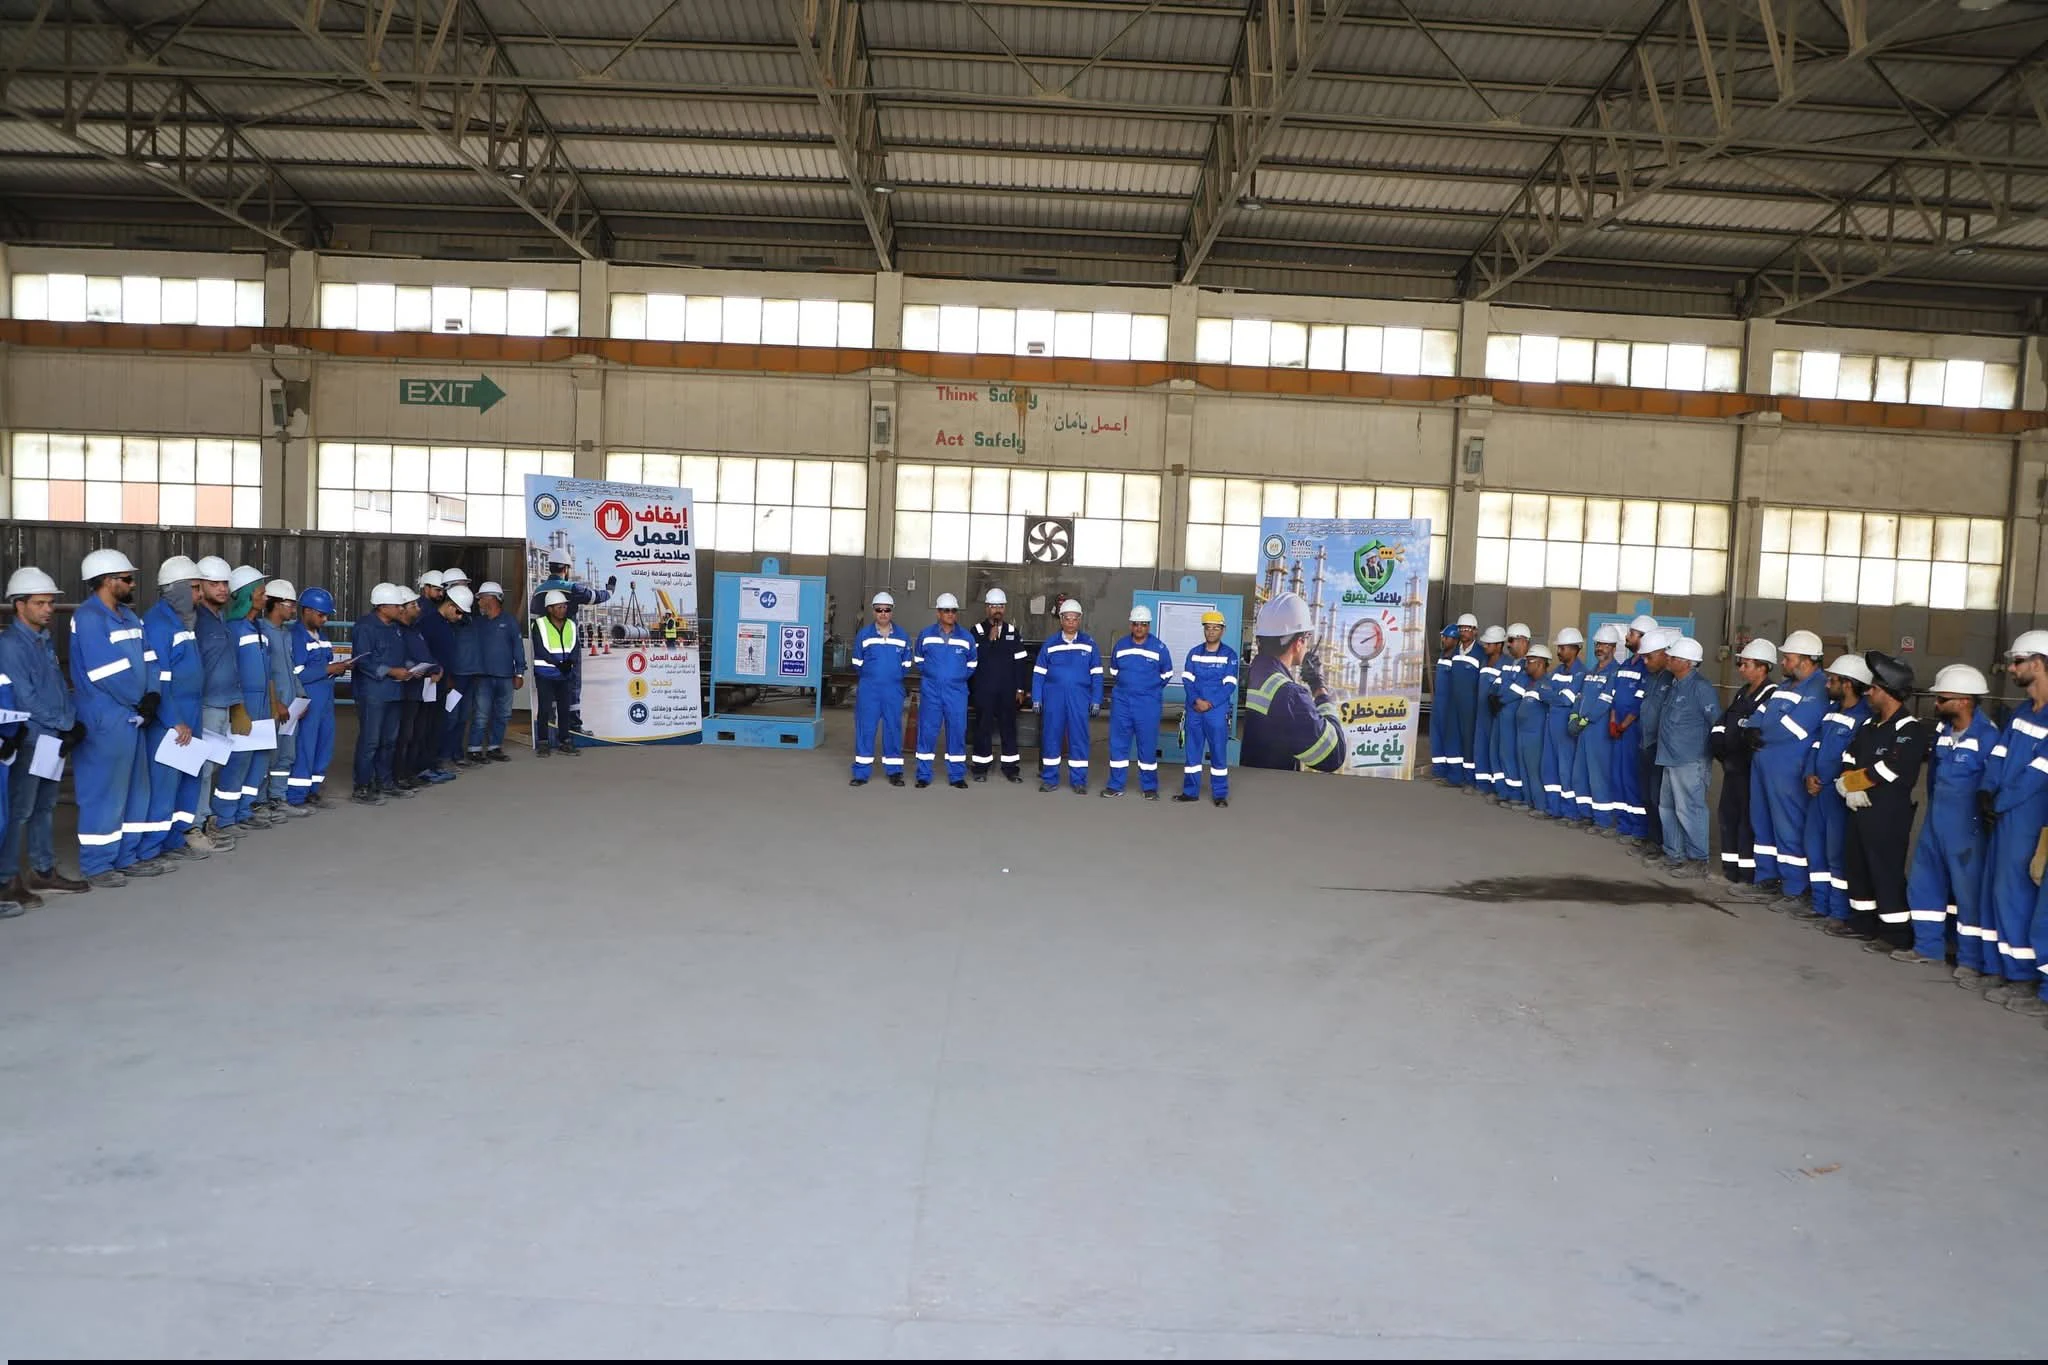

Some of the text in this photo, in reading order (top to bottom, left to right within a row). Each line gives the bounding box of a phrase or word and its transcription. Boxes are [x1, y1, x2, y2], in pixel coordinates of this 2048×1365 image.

[407, 382, 474, 403] EXIT
[935, 386, 978, 402] Think
[935, 430, 1026, 455] Act Safely
[561, 499, 583, 508] EMC
[635, 505, 688, 529] إيقاف
[633, 525, 689, 546] العمل
[1290, 539, 1312, 547] EMC
[614, 548, 690, 564] صلاحية للجميع
